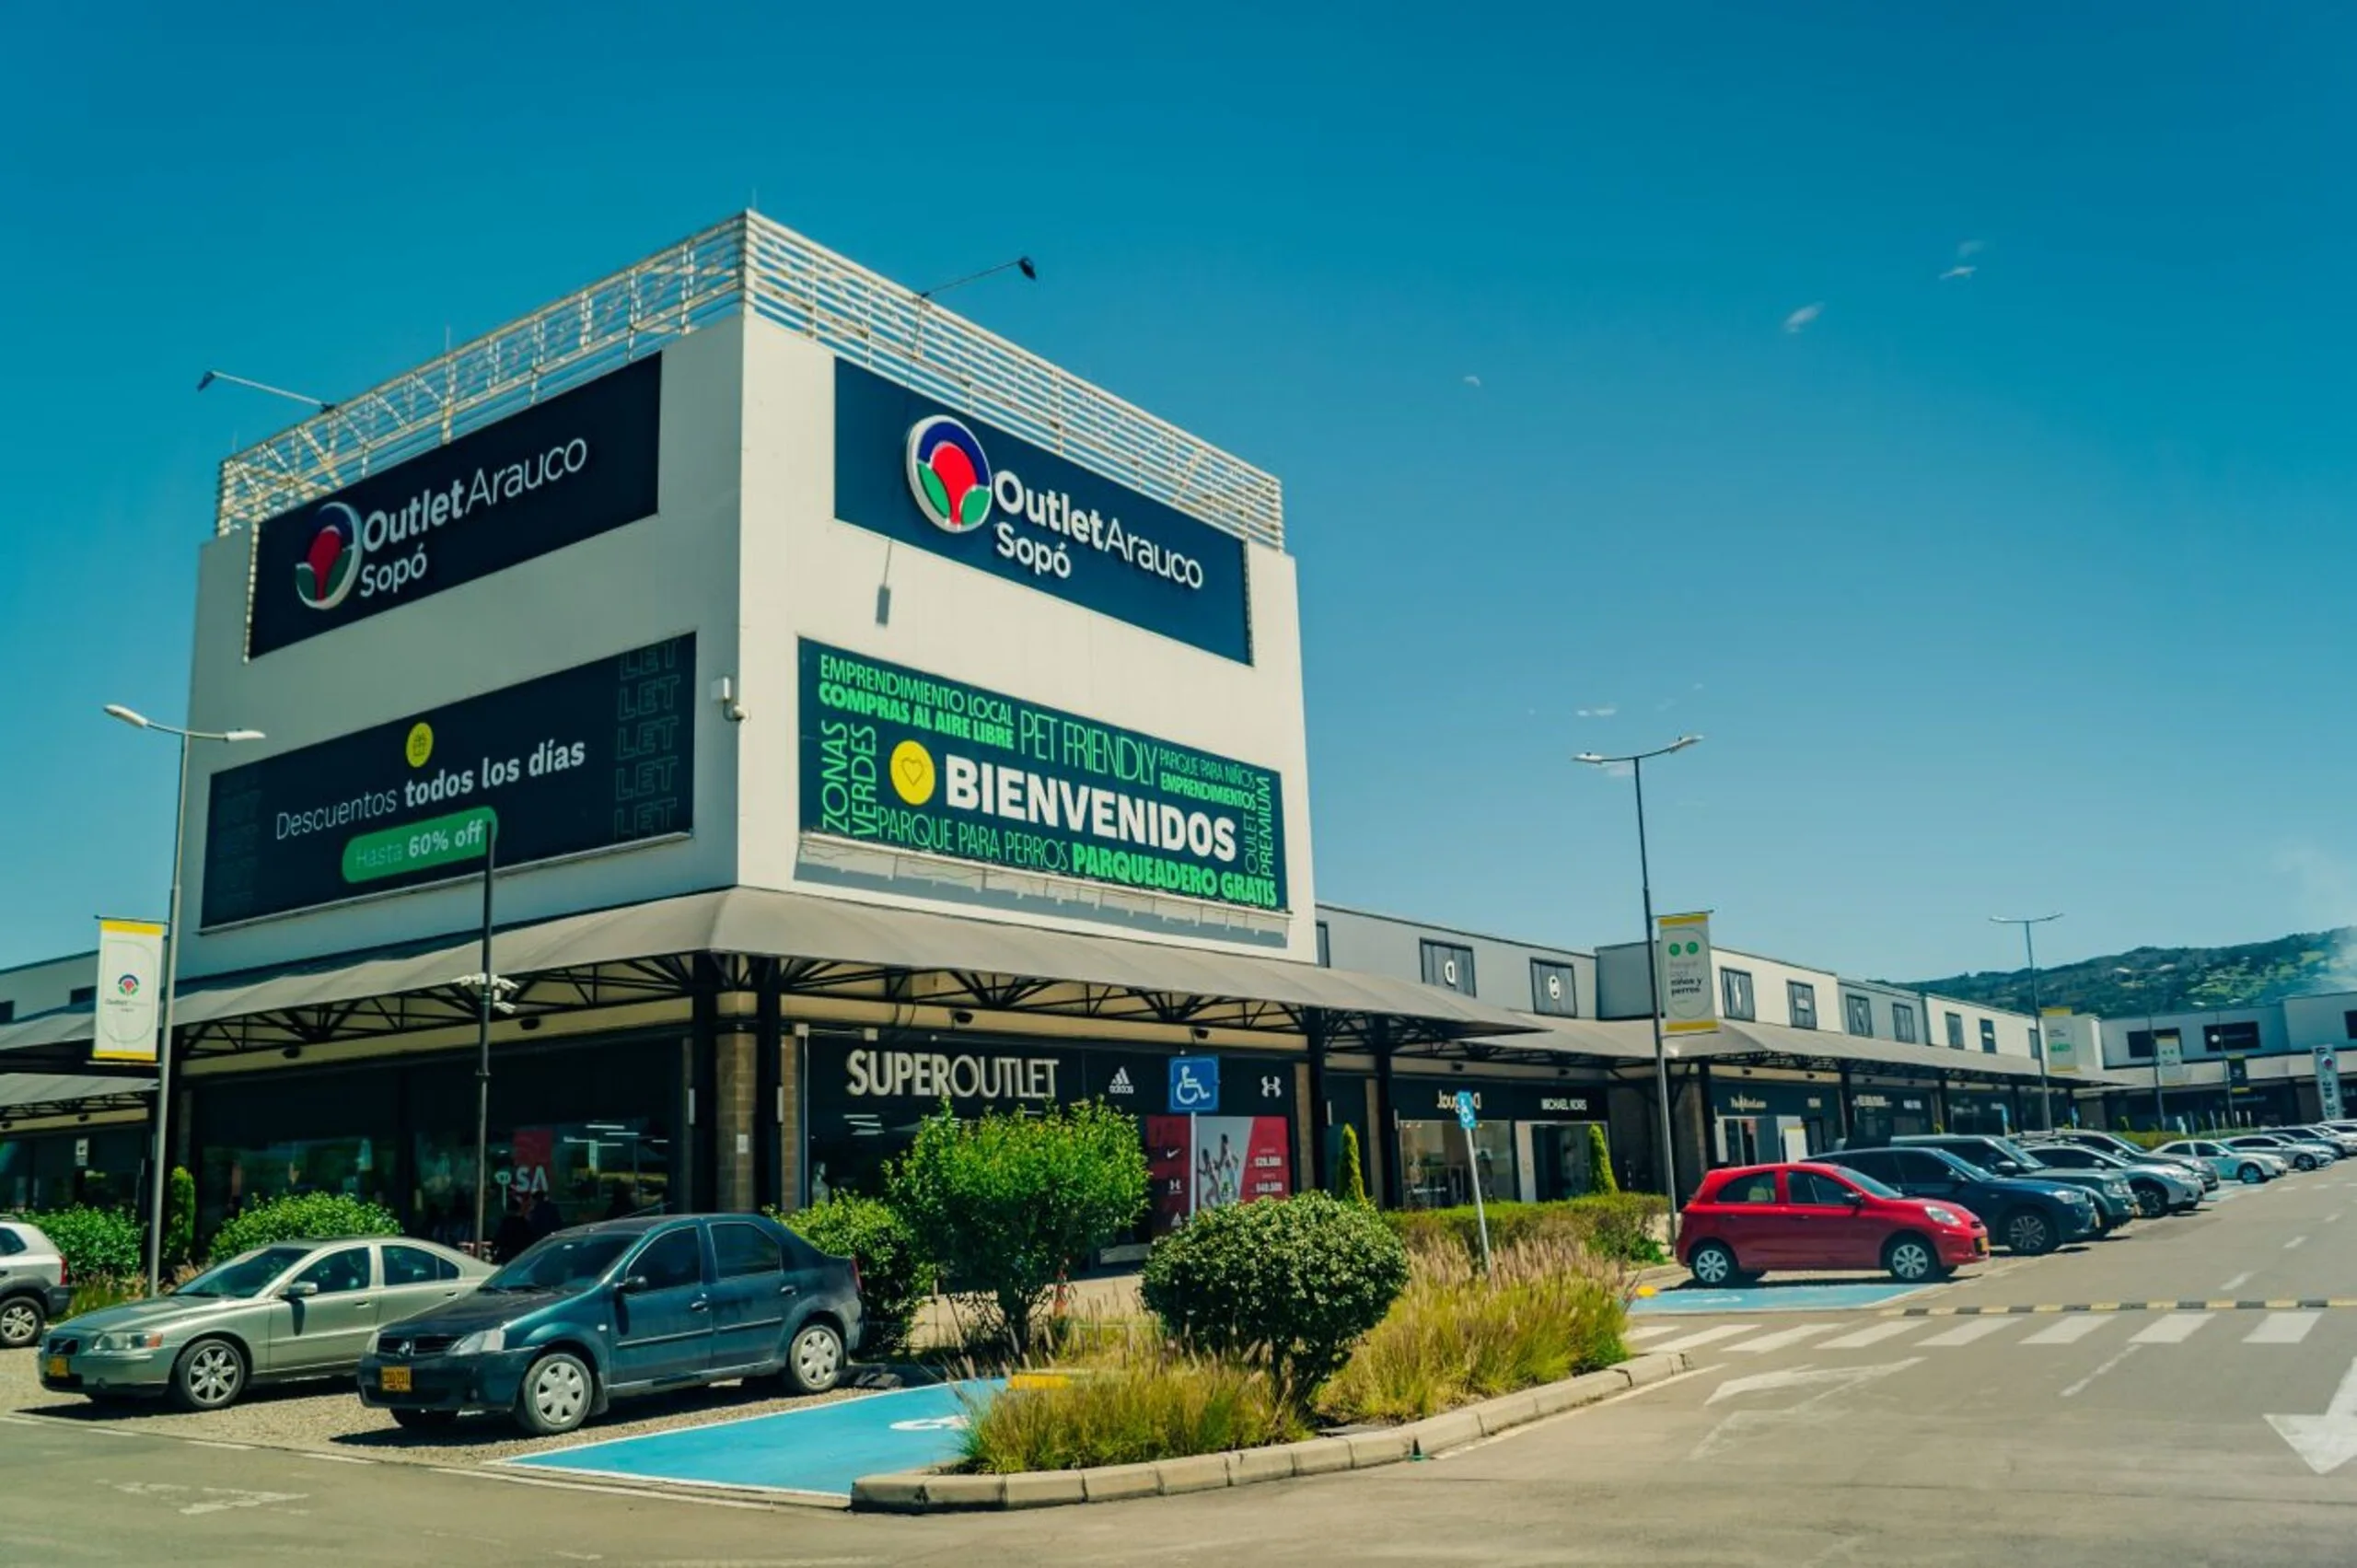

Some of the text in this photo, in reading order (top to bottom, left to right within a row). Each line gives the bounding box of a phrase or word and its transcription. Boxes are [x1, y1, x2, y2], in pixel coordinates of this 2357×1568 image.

[360, 542, 427, 598] Sopó
[995, 522, 1071, 579] Sopó
[618, 674, 680, 721] LET
[819, 681, 1014, 749] COMPRAS AL AIRE LIBRE
[820, 654, 1014, 726] EMPRENDIMIENTO LOCAL
[616, 714, 679, 761] LET
[1020, 710, 1160, 786] PET FRIENDLY
[1160, 749, 1199, 776] PARQUE
[1200, 759, 1224, 782] PARA
[276, 739, 585, 841] Descuentos todos los días
[615, 755, 679, 801] LET
[821, 719, 849, 832] ZONAS
[850, 724, 877, 836] VERDES
[1160, 772, 1256, 810] EMPRENDIMIENTOS
[877, 807, 1068, 870] PARQUE PARA PERROS
[946, 753, 1236, 862] BIENVENIDOS
[1257, 777, 1274, 877] PREMIUM
[355, 819, 483, 868] Hasta 60% off
[1072, 842, 1277, 906] PARQUEADERO GRATIS
[845, 1049, 1059, 1099] SUPEROUTLET
